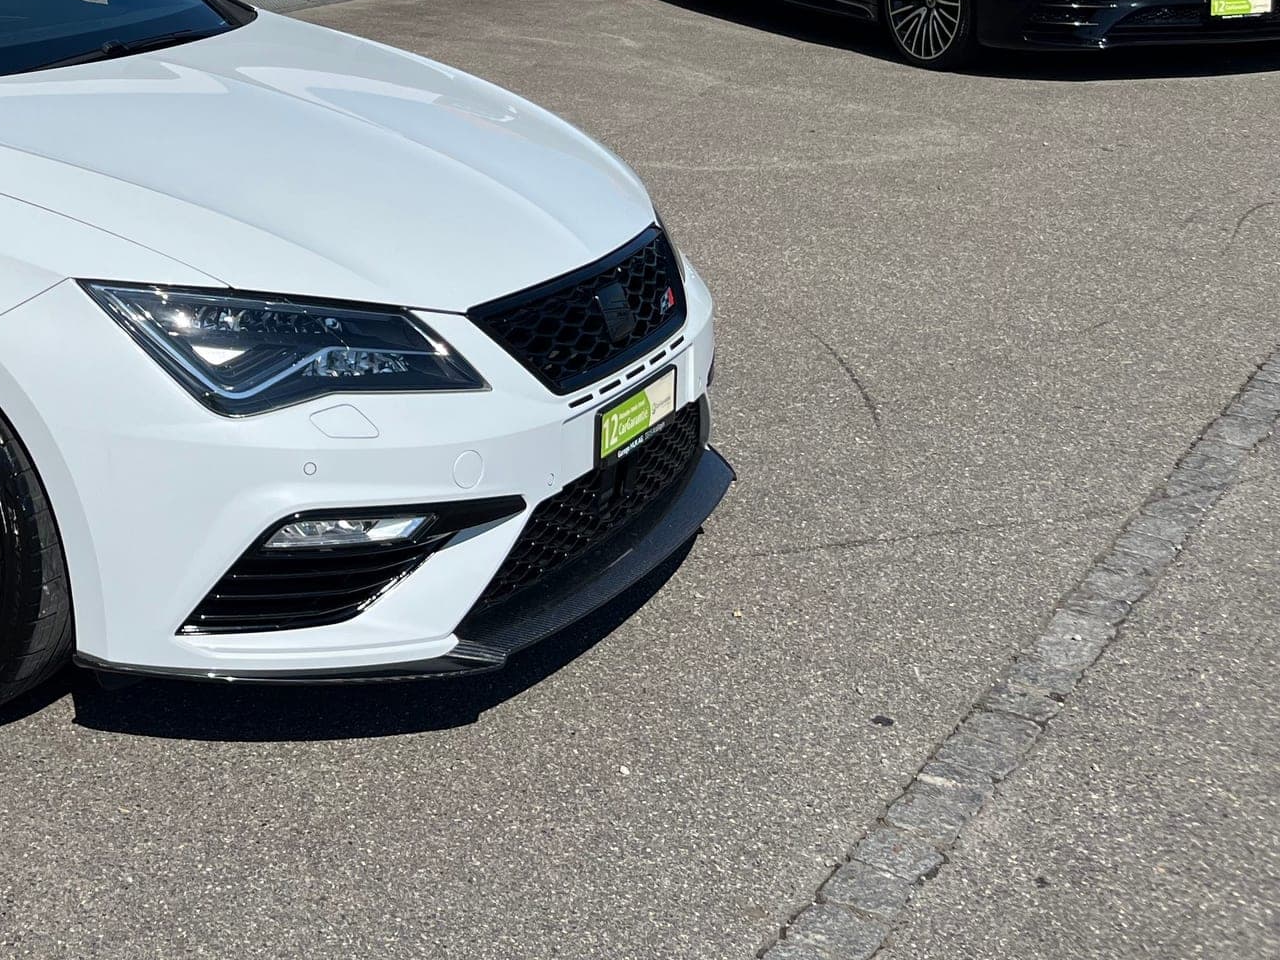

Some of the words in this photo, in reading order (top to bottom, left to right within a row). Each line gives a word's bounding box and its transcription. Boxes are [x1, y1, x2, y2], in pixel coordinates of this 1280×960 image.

[1213, 0, 1226, 13] 12
[602, 413, 619, 450] 12
[618, 408, 649, 435] CarGarantie
